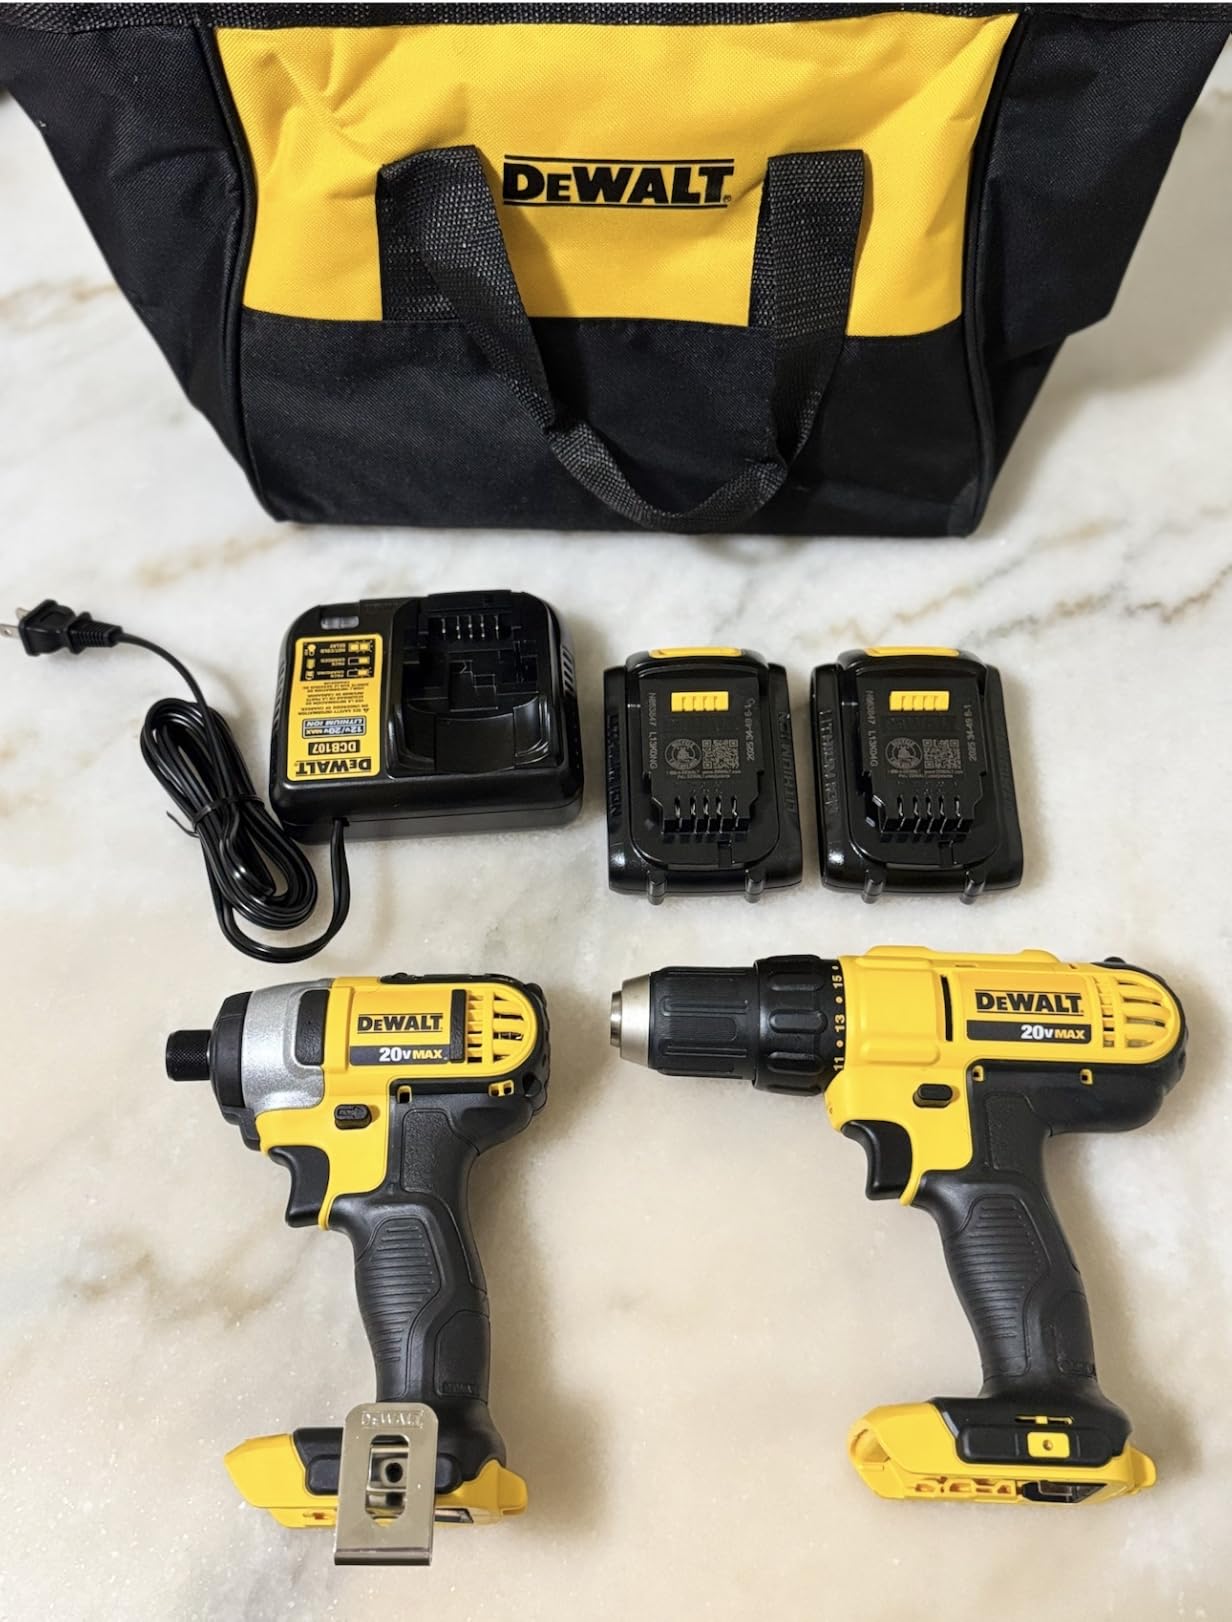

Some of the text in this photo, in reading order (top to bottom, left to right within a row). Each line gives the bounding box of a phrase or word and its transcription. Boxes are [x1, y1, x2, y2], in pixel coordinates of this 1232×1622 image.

[312, 741, 357, 754] DCB107
[832, 974, 843, 988] 15
[834, 1015, 845, 1032] 13
[1021, 1024, 1085, 1040] 20V MAX
[379, 1047, 443, 1062] 20V MAX
[833, 1057, 845, 1071] 11
